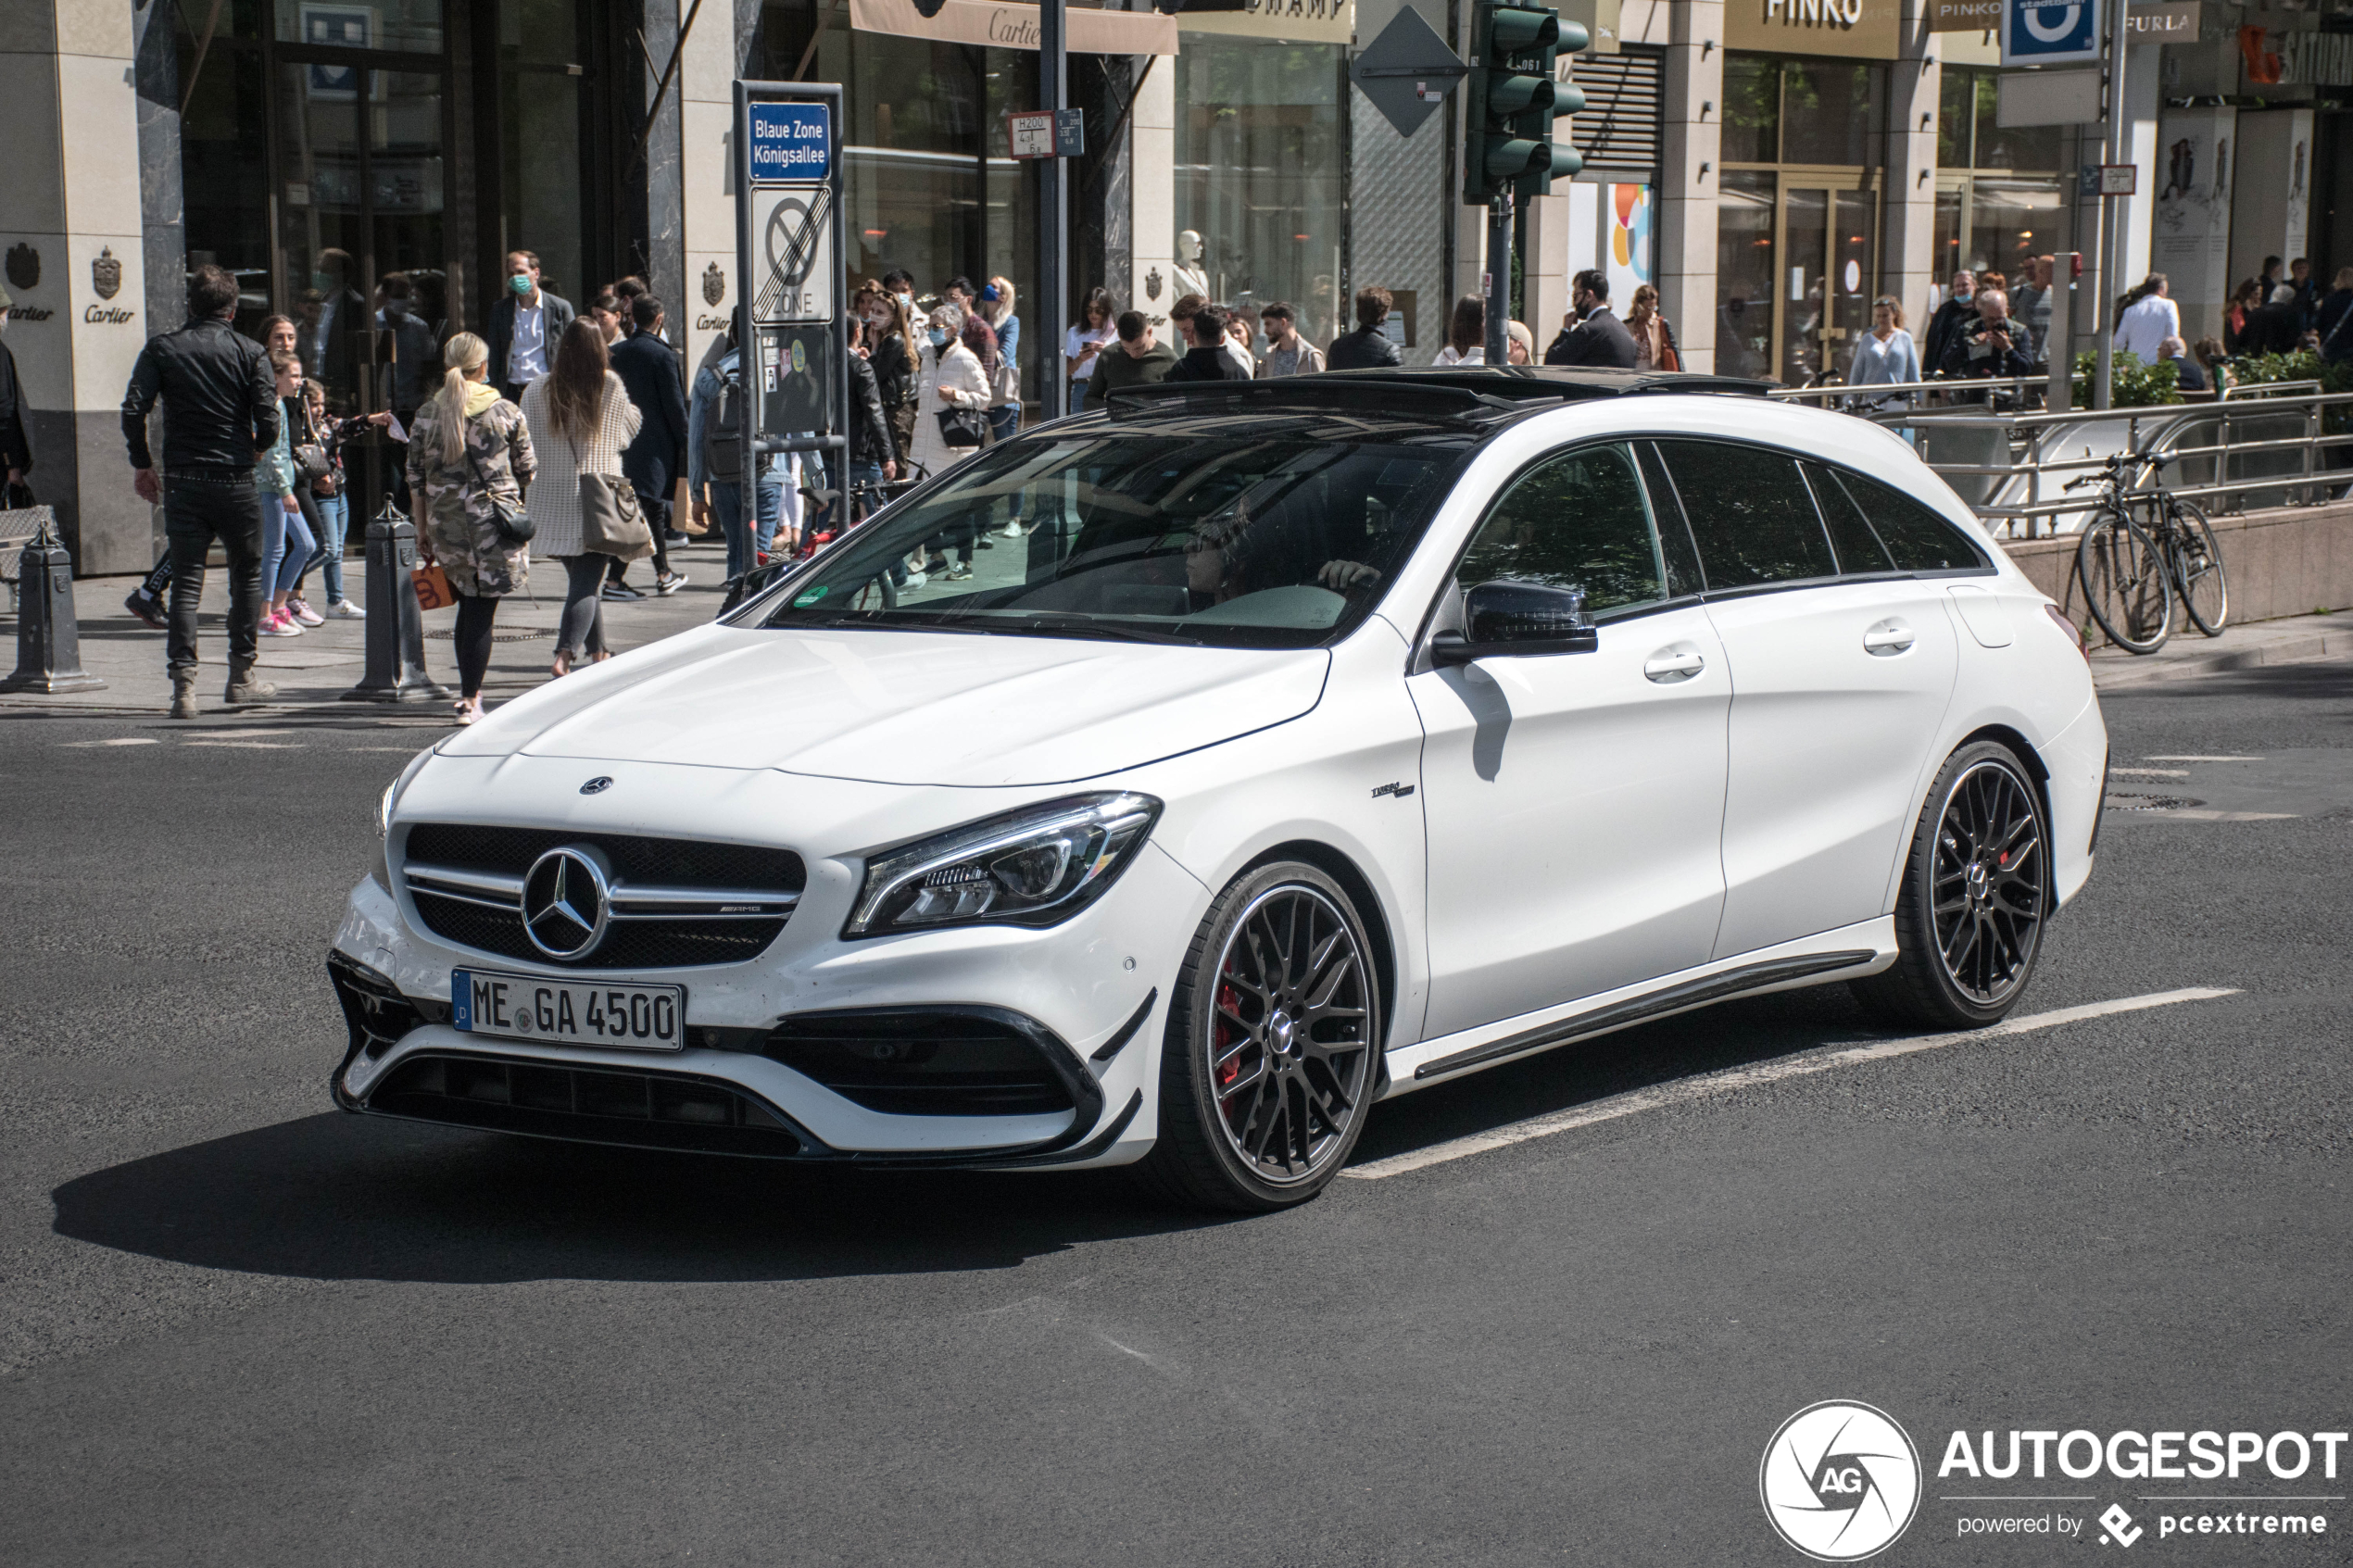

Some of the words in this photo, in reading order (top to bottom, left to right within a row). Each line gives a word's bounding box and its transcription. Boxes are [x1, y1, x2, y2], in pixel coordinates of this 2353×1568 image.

[1768, 0, 1863, 24] PINKO
[1940, 2, 2002, 18] PINKO
[988, 7, 1041, 44] Cartie
[2126, 15, 2189, 32] FURLA
[1521, 60, 1540, 70] 061
[755, 119, 790, 139] Blaue
[793, 119, 823, 139] Zone
[754, 144, 825, 168] Königsallee
[7, 304, 54, 321] artier
[773, 293, 812, 314] ZONE
[84, 304, 135, 324] Cartier
[697, 314, 731, 331] Cartier
[459, 1007, 467, 1020] D
[472, 979, 510, 1027] ME
[535, 987, 576, 1035] GA
[585, 990, 674, 1040] 4500
